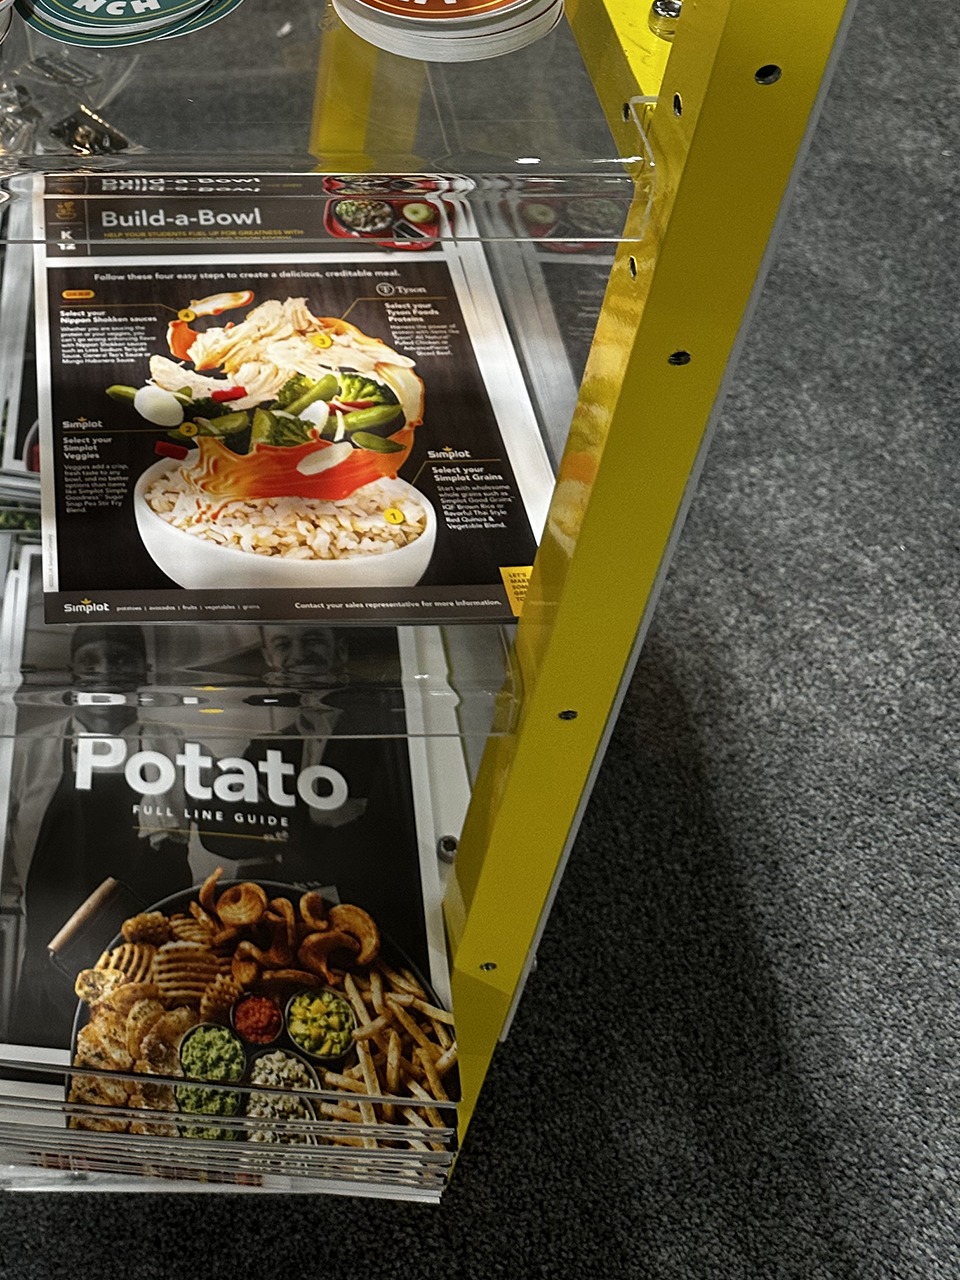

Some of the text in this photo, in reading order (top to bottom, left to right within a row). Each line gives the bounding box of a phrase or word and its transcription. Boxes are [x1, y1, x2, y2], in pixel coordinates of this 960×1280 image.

[101, 208, 262, 228] Build-a-Bowl
[199, 272, 224, 280] steps
[396, 285, 427, 294] Tyson
[62, 420, 103, 430] Simplot
[63, 445, 98, 453] Simplot
[63, 453, 100, 461] Veggies
[427, 450, 471, 460] Simplot
[434, 475, 470, 483] Simplot
[64, 602, 110, 614] Simplot
[325, 602, 343, 610] your
[365, 601, 420, 610] representative
[455, 599, 502, 607] information.
[75, 732, 349, 811] Potato
[132, 804, 289, 827] FULL LINE GUIDE
